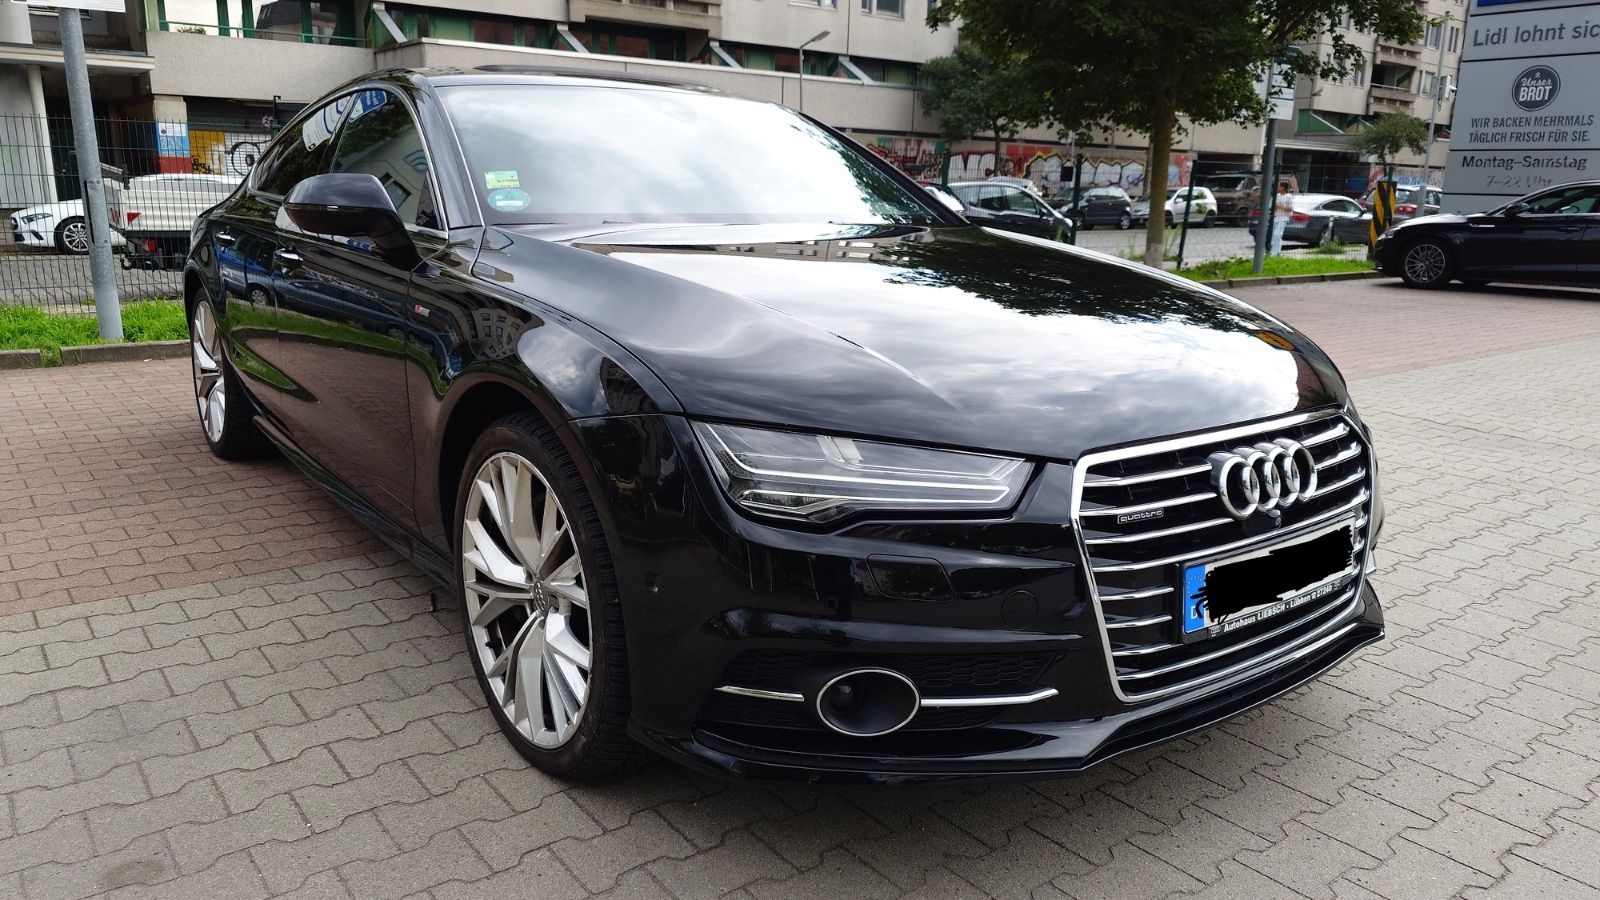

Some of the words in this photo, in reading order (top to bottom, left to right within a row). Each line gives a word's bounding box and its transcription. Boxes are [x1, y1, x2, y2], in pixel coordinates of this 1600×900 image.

[1473, 27, 1508, 46] Lidl
[1514, 23, 1566, 43] lohnt
[1521, 77, 1553, 87] Unser
[1519, 86, 1553, 102] BROT
[1471, 117, 1490, 128] WIR
[1492, 116, 1531, 128] BACKEN
[1533, 114, 1595, 127] MEHRMALS
[1469, 130, 1507, 143] TÄGLICH
[1509, 131, 1546, 142] FRISCH
[1548, 129, 1569, 142] FÜR
[1571, 130, 1591, 142] SIE.
[1120, 510, 1163, 523] quattro
[1223, 615, 1256, 632] Autohaus
[1257, 603, 1286, 620] LIEBSCH
